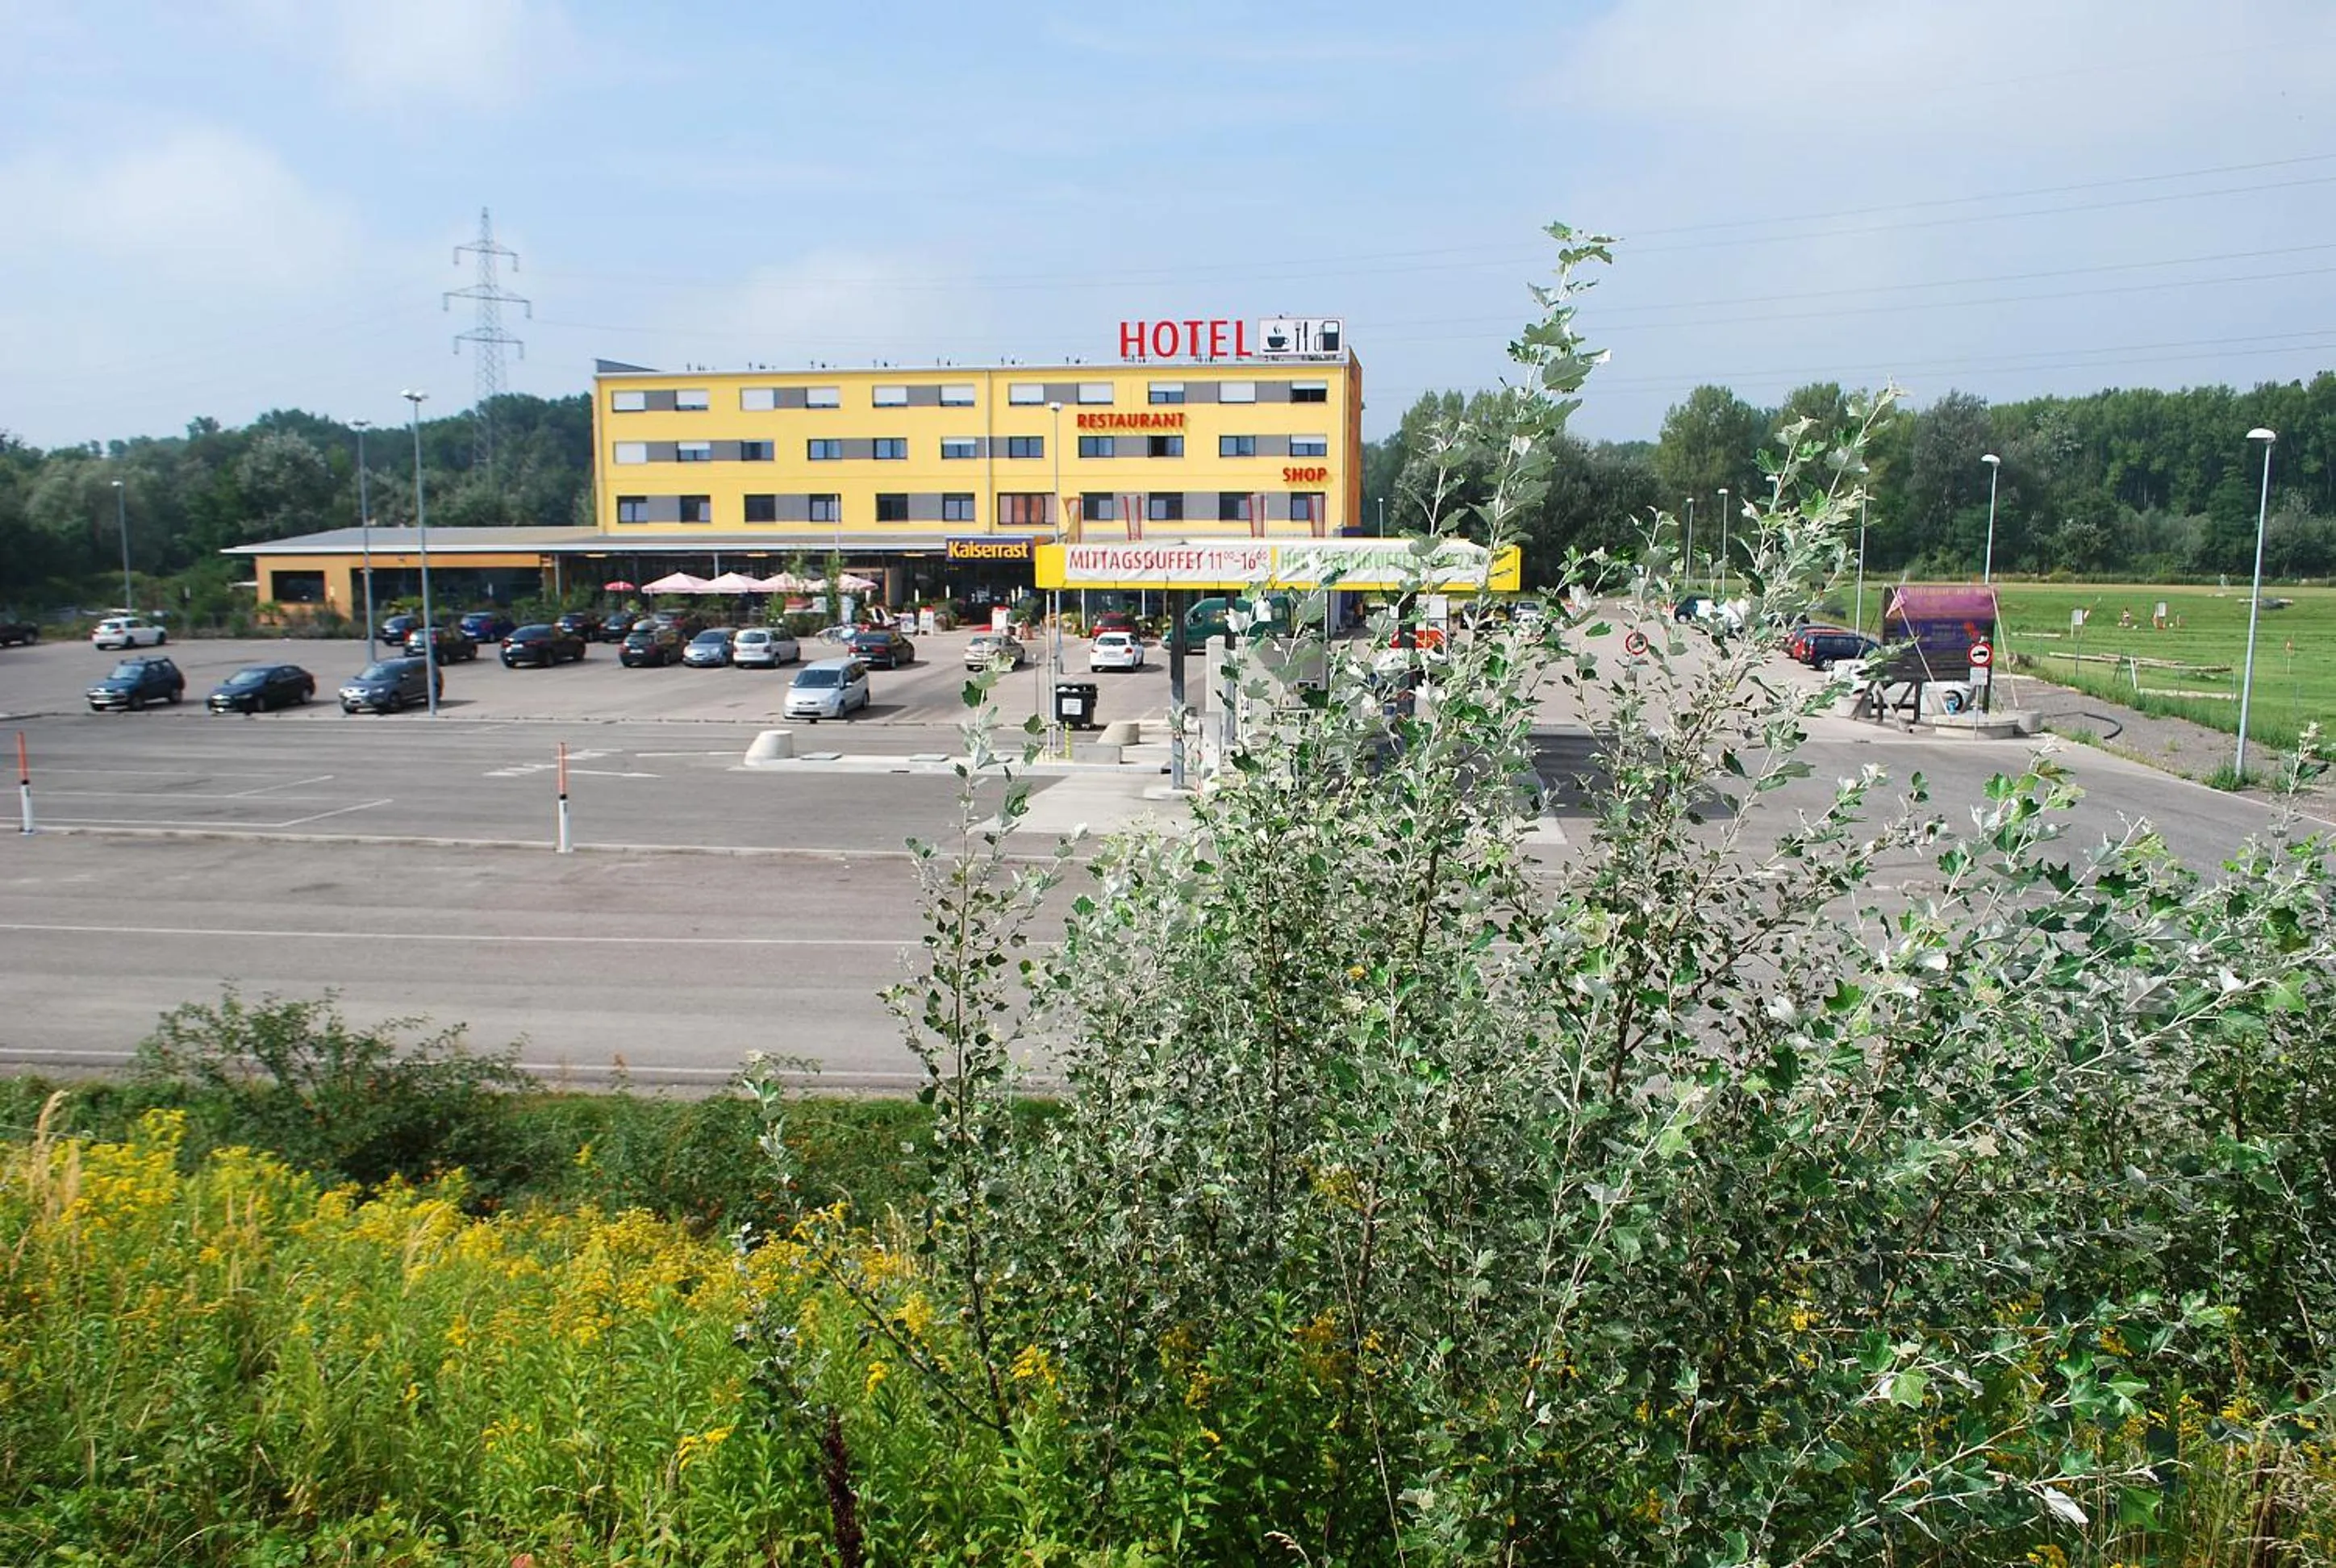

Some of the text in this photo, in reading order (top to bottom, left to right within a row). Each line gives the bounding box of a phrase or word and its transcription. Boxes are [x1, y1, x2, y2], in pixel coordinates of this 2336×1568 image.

[1120, 320, 1253, 357] HOTEL
[1077, 412, 1185, 428] RESTAURANT
[1283, 466, 1327, 482] SHOP
[947, 540, 1029, 559] Kaiserrast
[1069, 550, 1203, 569] MITTAGSBUFFET
